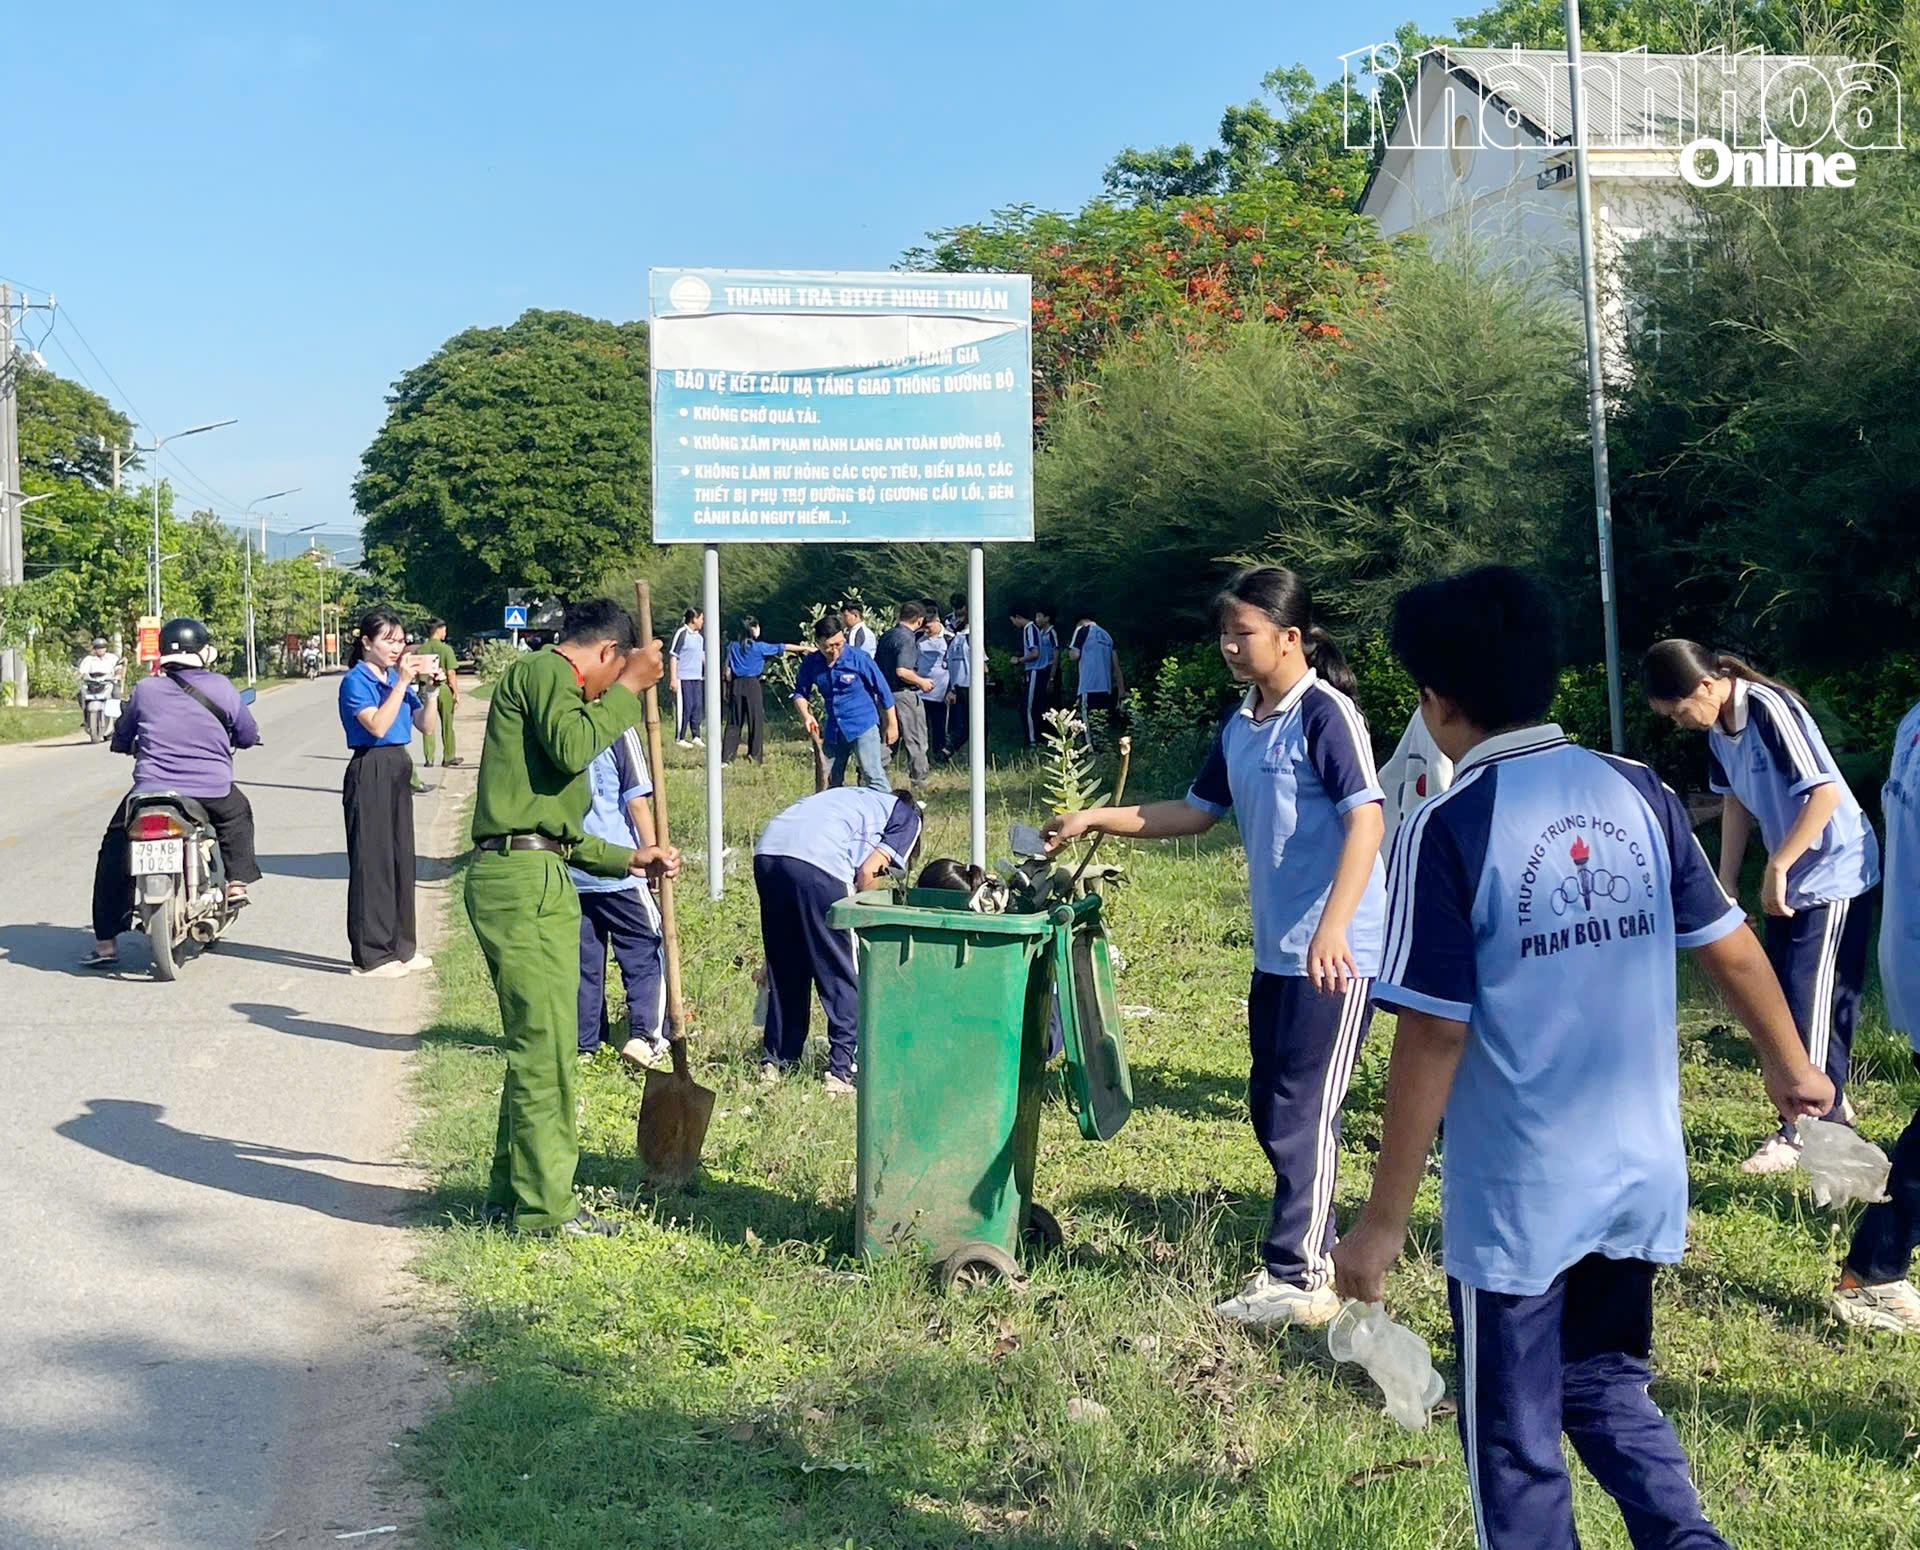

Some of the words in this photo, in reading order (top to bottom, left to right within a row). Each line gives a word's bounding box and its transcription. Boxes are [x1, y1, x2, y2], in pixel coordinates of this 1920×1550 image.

[724, 287, 791, 306] THANH
[795, 288, 834, 307] TRA
[890, 289, 939, 308] NINH
[944, 287, 1009, 313] THUẬN
[956, 345, 980, 365] GIA
[708, 370, 726, 395] VỆ
[729, 369, 757, 393] KẾT
[793, 377, 813, 398] HẠ
[857, 377, 891, 395] GIAO
[894, 372, 941, 395] THÔNG
[944, 371, 992, 393] ĐƯỜNG
[995, 367, 1015, 392] BỘ
[693, 404, 739, 423] KHÔNG
[740, 405, 768, 424] CHỞ
[768, 407, 795, 424] QUÁ
[693, 433, 739, 451] KHÔNG
[740, 435, 770, 451] XÂM
[772, 437, 810, 454] PHẠM
[812, 435, 848, 451] HÀNH
[850, 437, 883, 452] LANG
[885, 437, 903, 451] AN
[904, 435, 939, 451] TOÀN
[940, 432, 983, 450] ĐƯỜNG
[984, 431, 1005, 451] BỘ.
[695, 462, 739, 480] KHÔNG
[742, 464, 771, 480] LÀM
[773, 464, 793, 480] HƯ
[832, 463, 859, 480] CÁC
[861, 465, 888, 482] CỌC
[890, 462, 922, 480] TIÊU,
[957, 462, 985, 479] BÁO,
[988, 460, 1013, 477] CÁC
[694, 484, 730, 503] THIẾT
[733, 487, 747, 505] BỊ
[751, 487, 778, 506] PHỤ
[782, 486, 806, 506] TRỢ
[810, 485, 854, 503] ĐƯỜNG
[858, 485, 876, 504] BỘ
[988, 482, 1014, 500] ĐÈN
[694, 506, 730, 525] CẢNH
[732, 508, 758, 525] BÁO
[760, 510, 798, 525] NGUY
[139, 856, 174, 872] 1025
[1518, 844, 1546, 926] TRƯỜNG
[1540, 815, 1586, 844] TRUNG
[1591, 816, 1628, 842] HỌC
[1521, 928, 1570, 958] PHAN
[1575, 916, 1612, 948] BỘI
